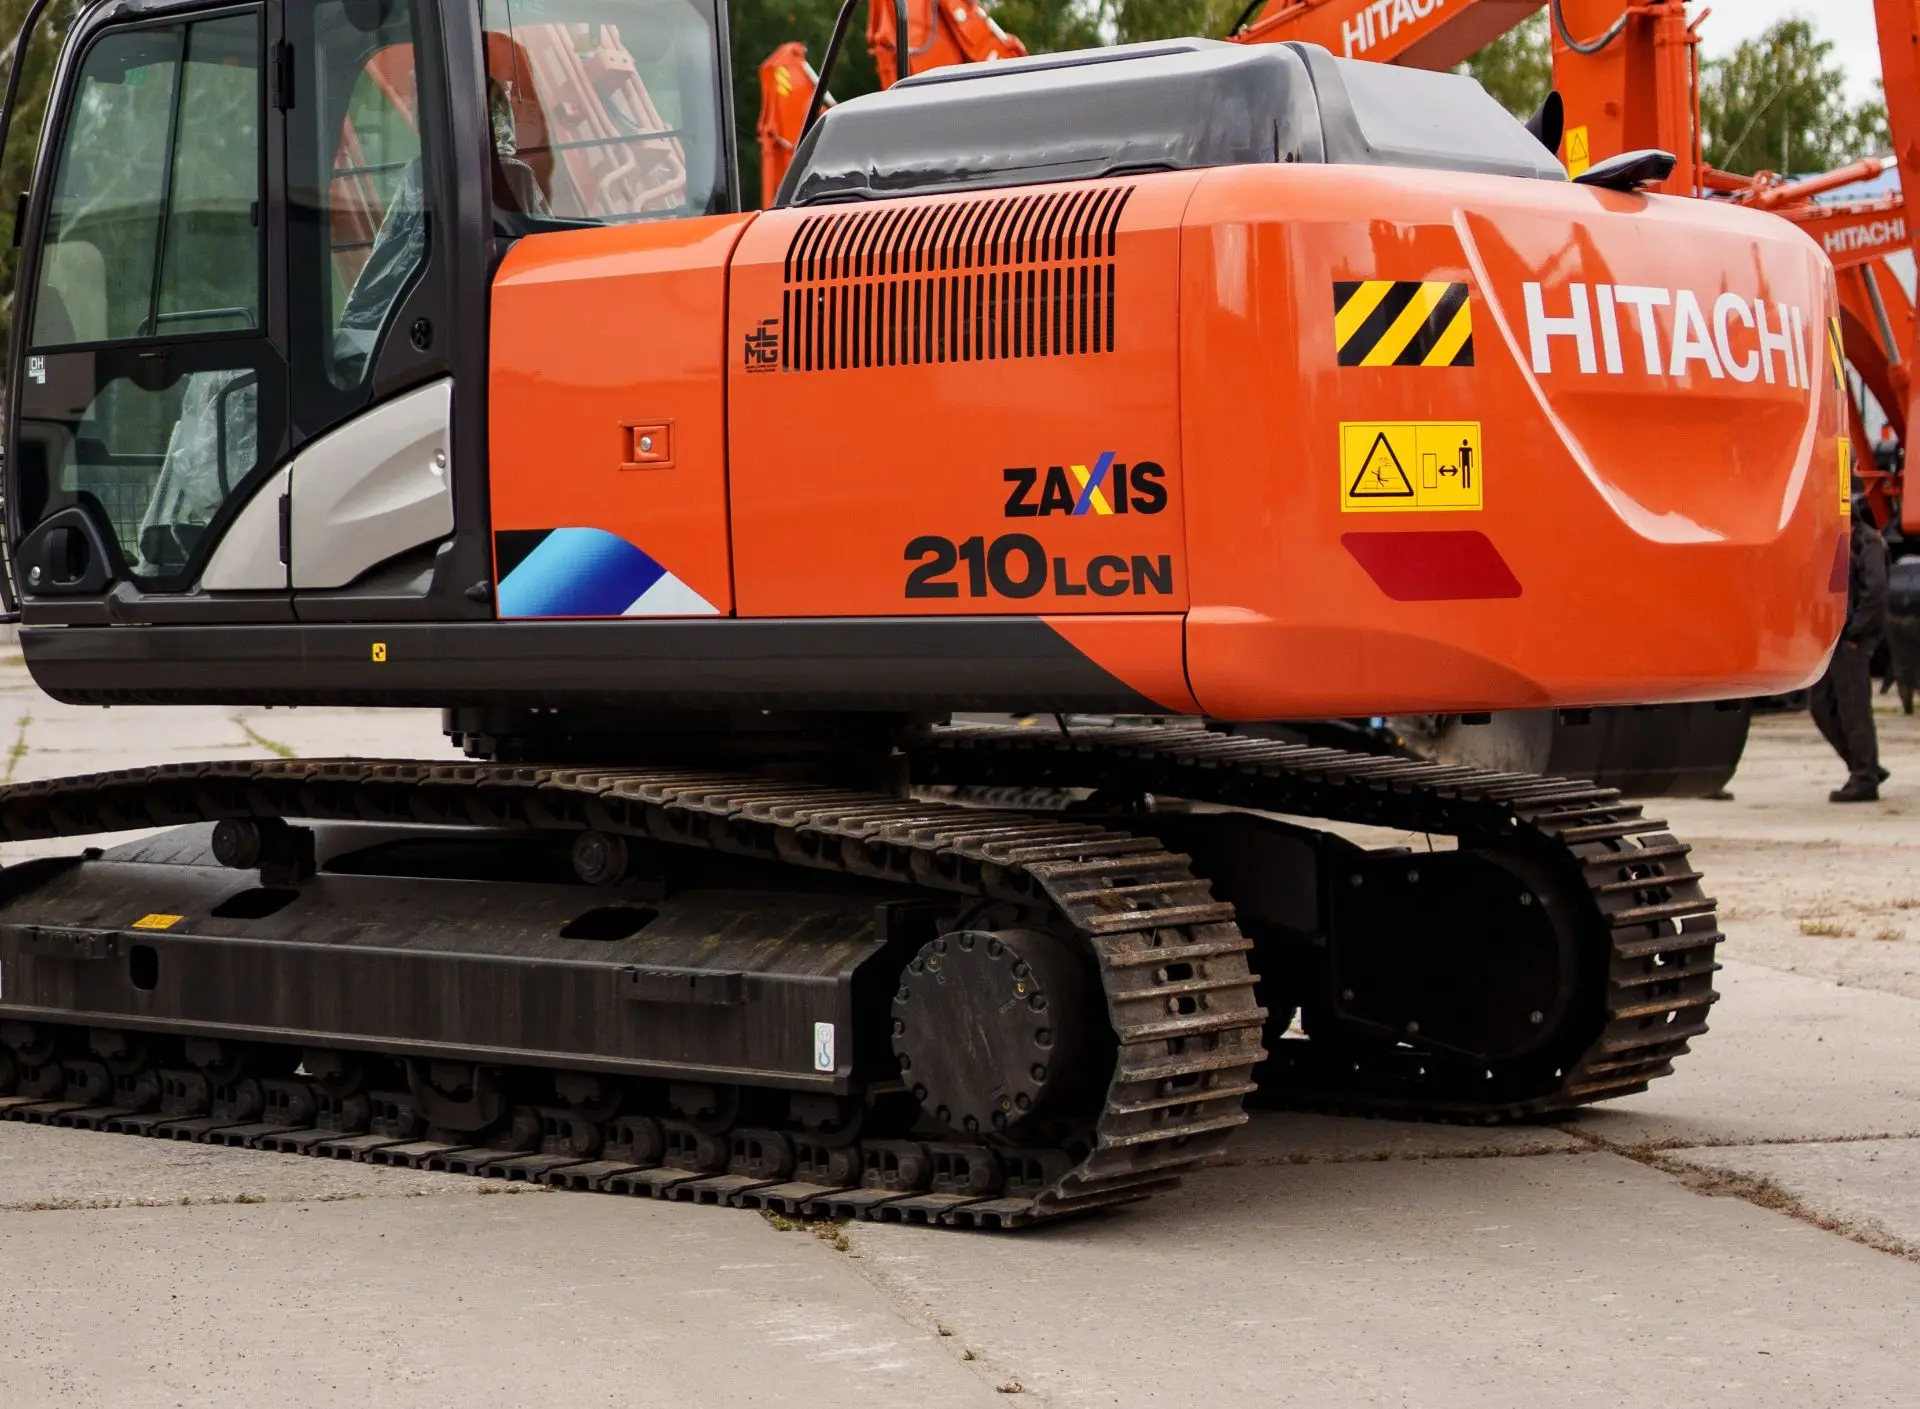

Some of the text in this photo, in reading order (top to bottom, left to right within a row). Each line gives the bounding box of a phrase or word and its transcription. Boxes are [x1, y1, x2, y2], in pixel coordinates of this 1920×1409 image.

[1823, 217, 1906, 255] HITACHI
[1522, 281, 1810, 389] HITACHI
[1003, 452, 1168, 517] ZAXIS
